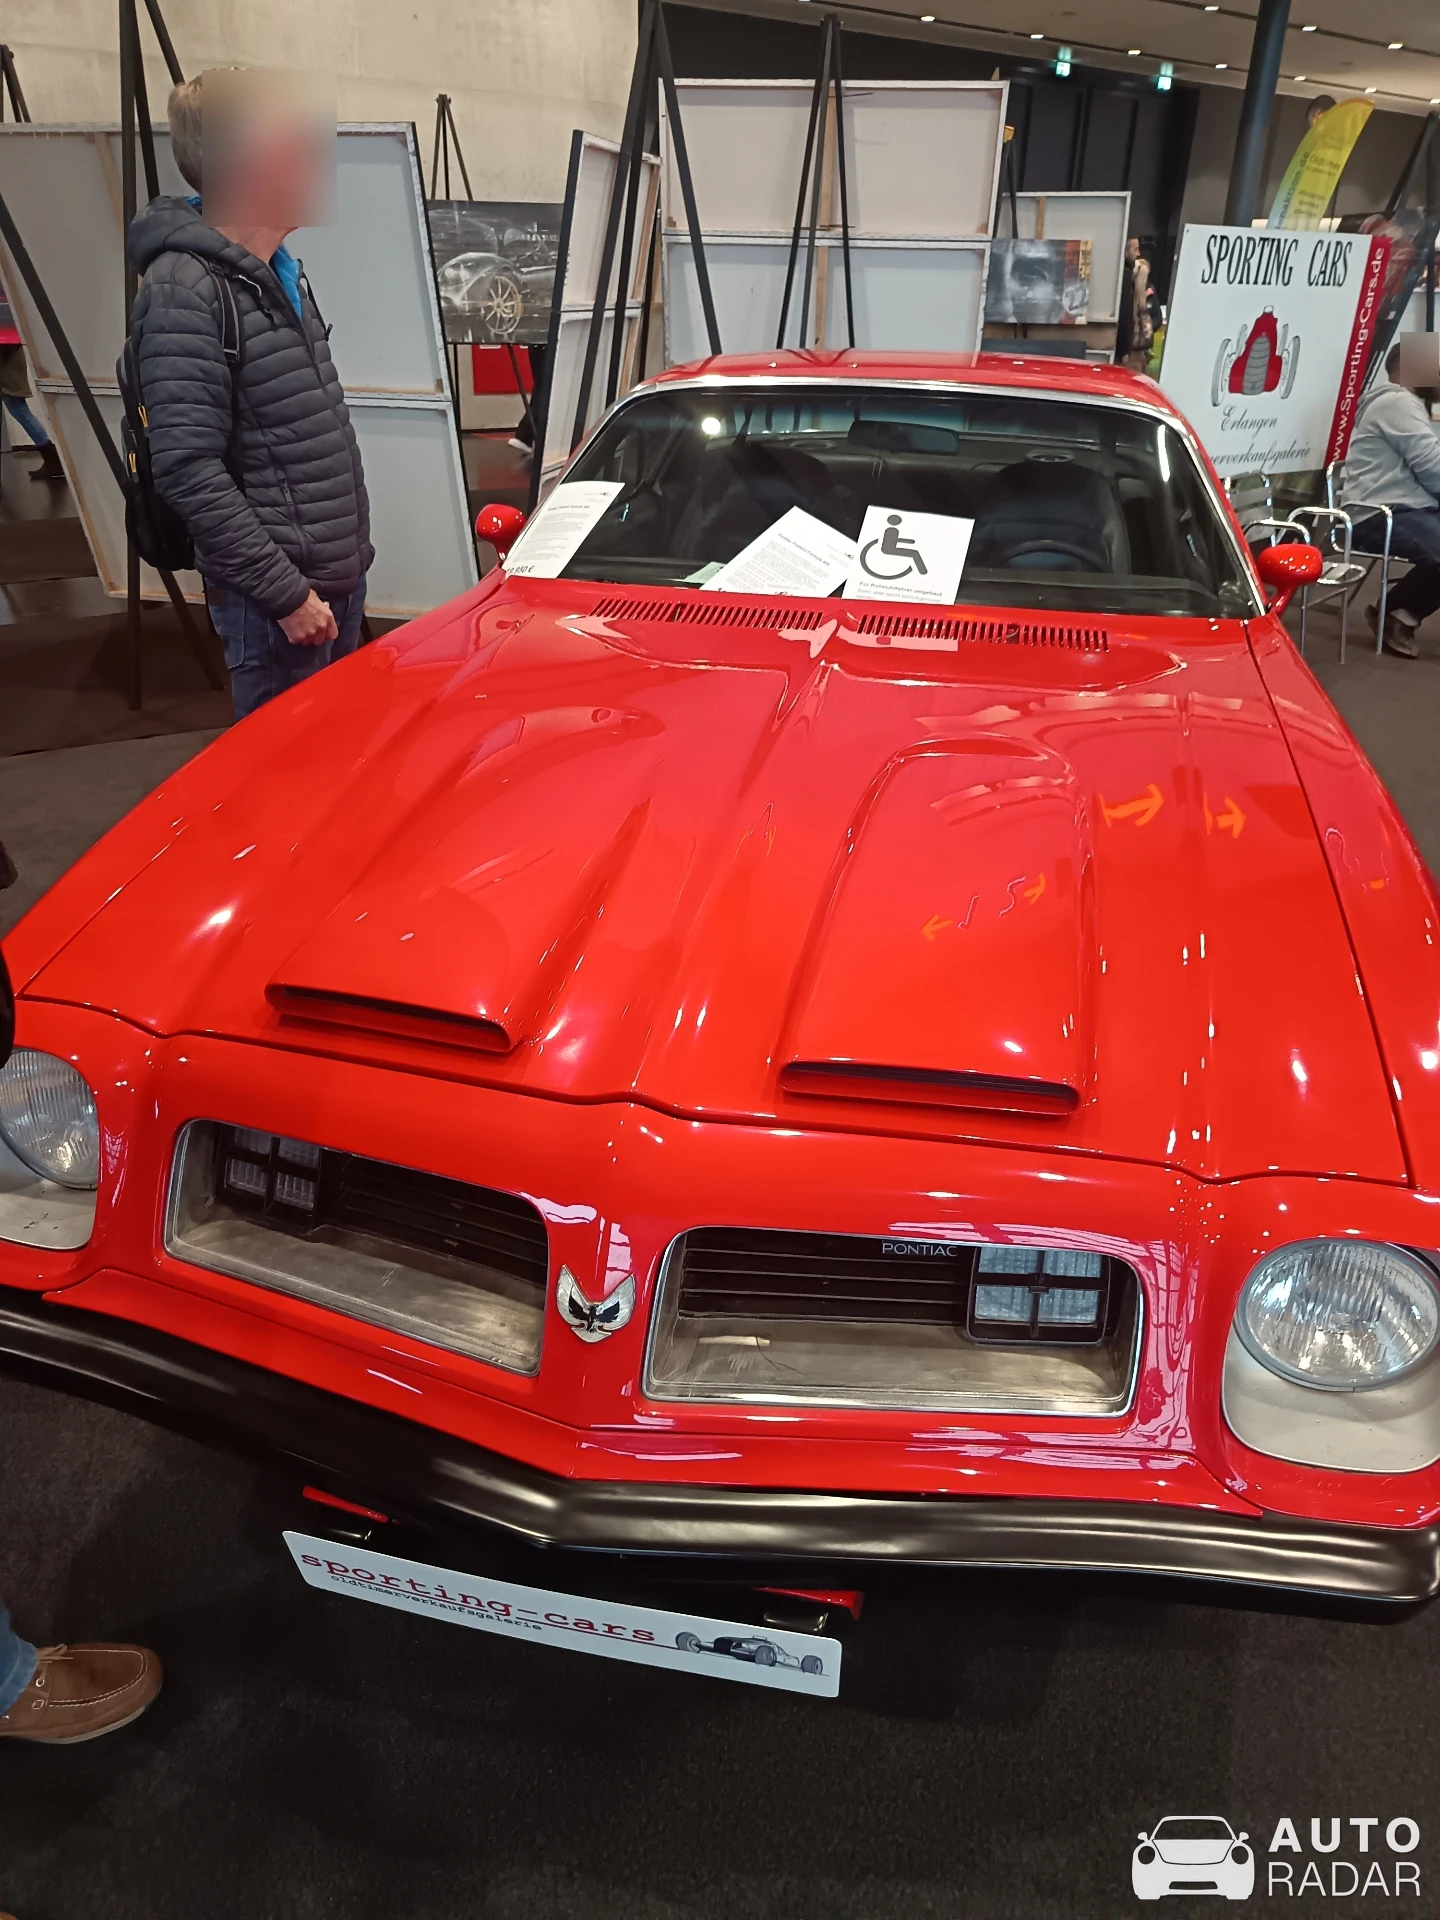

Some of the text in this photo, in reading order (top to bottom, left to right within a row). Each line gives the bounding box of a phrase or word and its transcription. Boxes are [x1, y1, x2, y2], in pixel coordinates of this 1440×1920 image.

[1200, 234, 1353, 288] SPORTING CARS
[1220, 405, 1279, 439] Erlangen
[881, 1242, 958, 1257] PONTIAC
[300, 1553, 656, 1643] sporting-cars
[330, 1574, 543, 1631] oldtimerverkaufsgalerie
